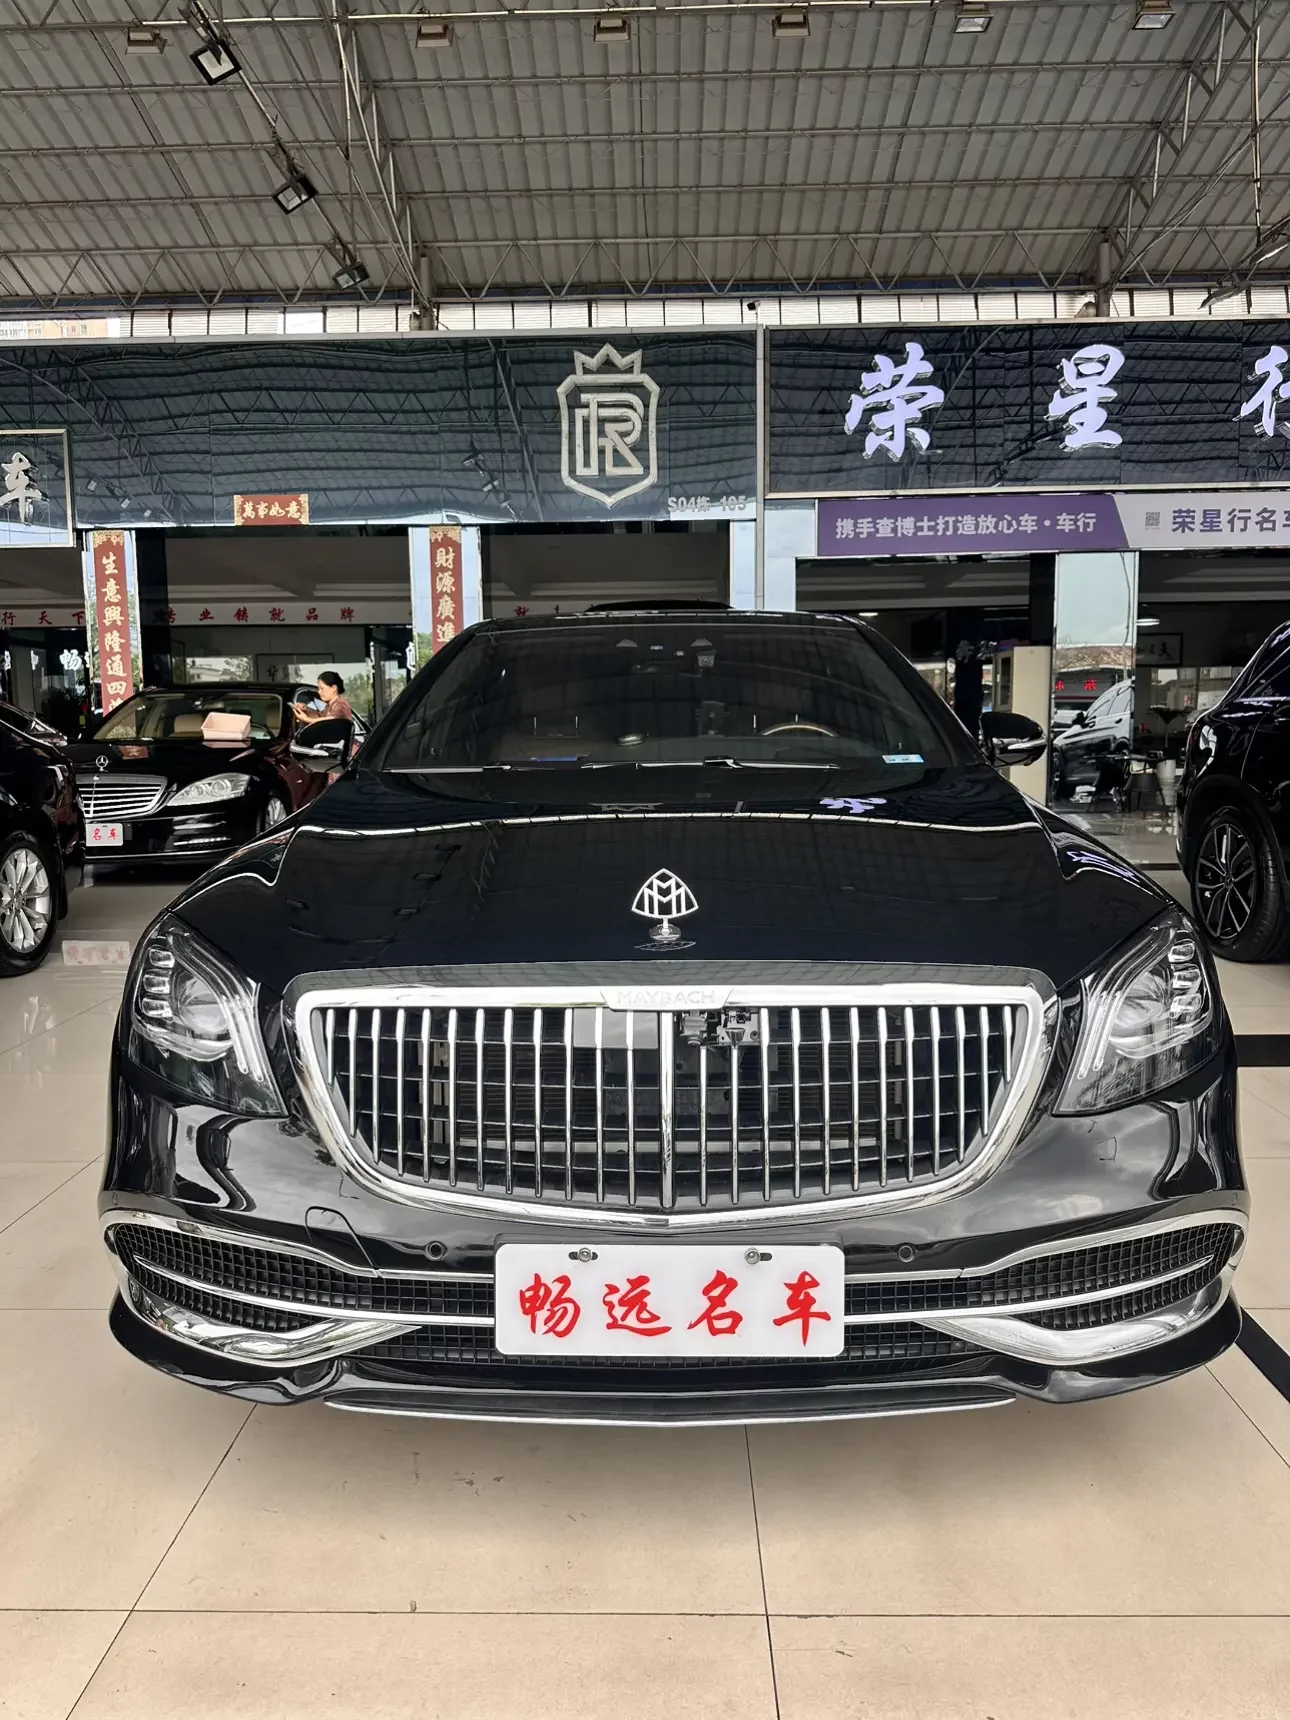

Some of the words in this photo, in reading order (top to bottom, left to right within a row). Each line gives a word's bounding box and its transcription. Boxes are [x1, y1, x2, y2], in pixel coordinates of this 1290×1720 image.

[242, 501, 301, 519] 萬事如意
[1171, 507, 1290, 534] 荣星行名
[617, 989, 715, 1004] MAYBACH
[518, 1269, 832, 1347] 畅远名车
